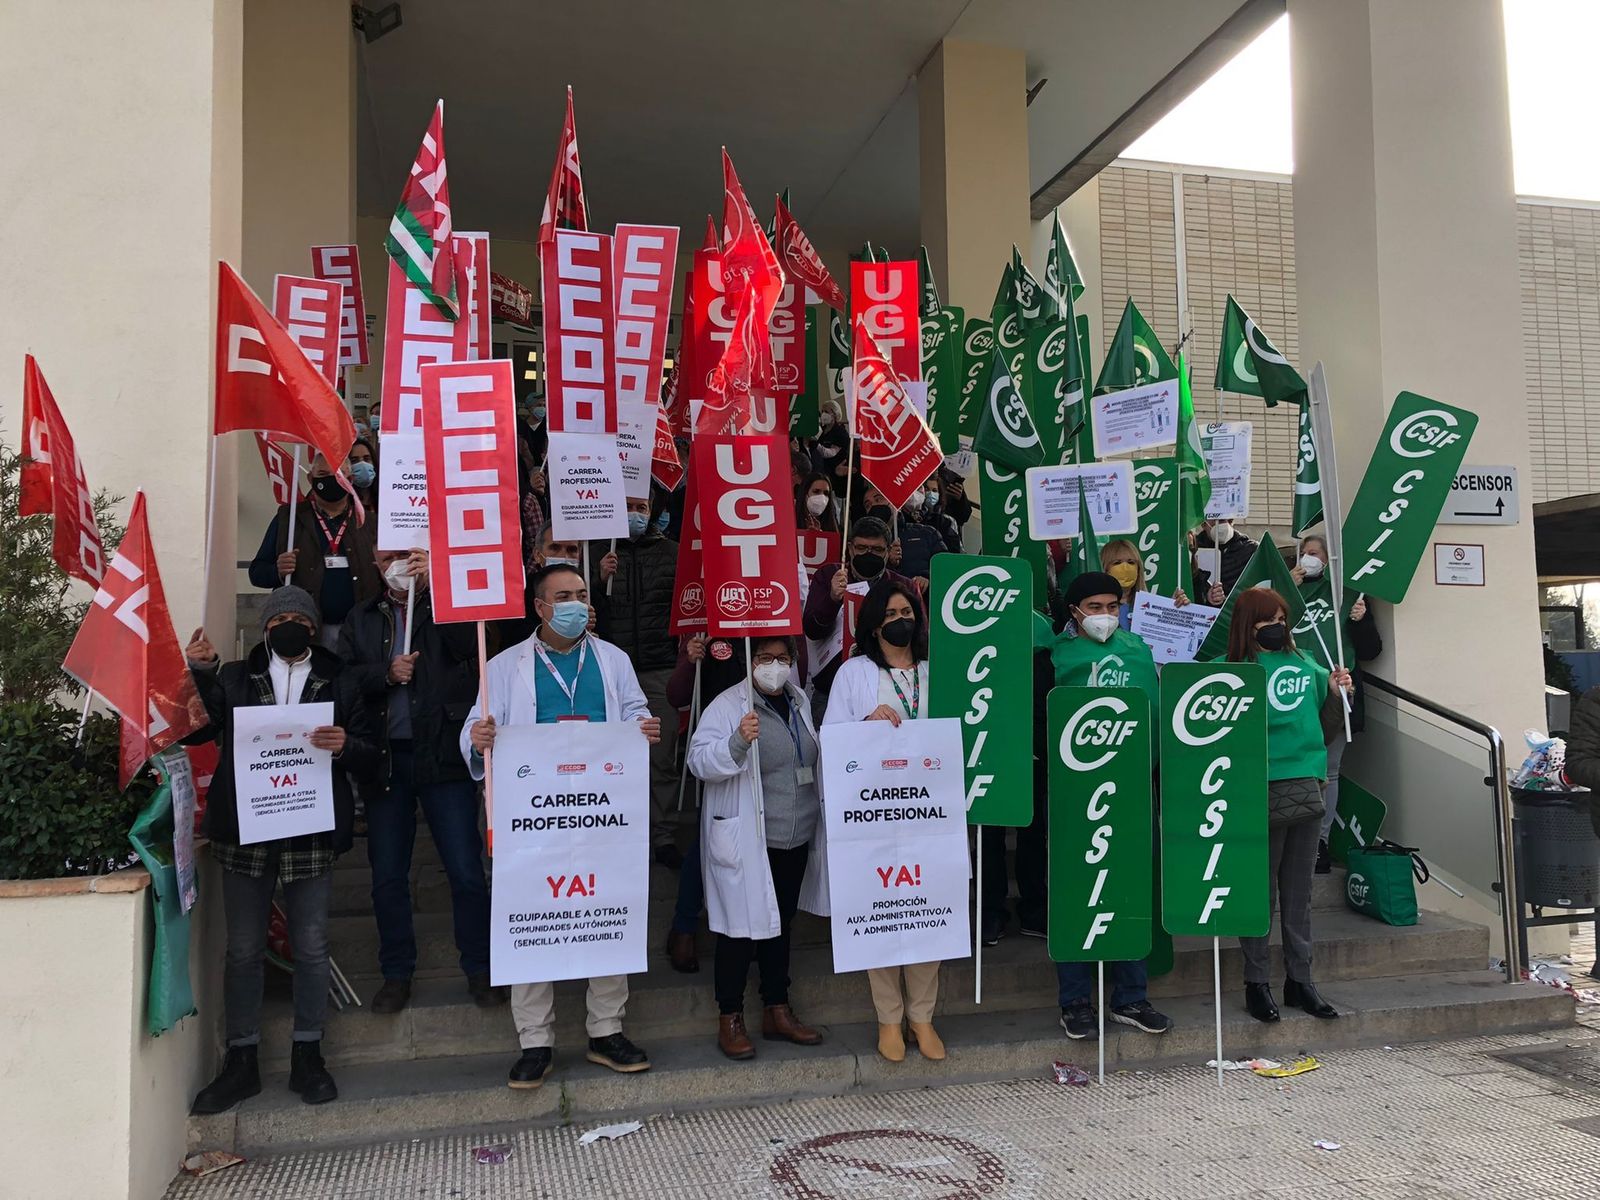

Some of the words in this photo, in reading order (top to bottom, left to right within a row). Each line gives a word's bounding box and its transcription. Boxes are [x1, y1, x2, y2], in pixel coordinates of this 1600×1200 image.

[557, 233, 605, 433] CCOO
[1406, 421, 1461, 449] CSIF
[560, 477, 611, 485] PROFESIONAL
[1452, 475, 1513, 492] SCENSOR
[439, 375, 506, 608] CCOO
[576, 489, 599, 499] YA!
[408, 496, 428, 507] YA
[715, 444, 777, 577] UGT
[1351, 469, 1424, 581] CSIF
[721, 588, 746, 602] UGT
[754, 588, 773, 598] FSP
[957, 586, 1021, 612] CSIF
[1098, 669, 1130, 687] CSIF
[1277, 675, 1311, 697] CSIF
[1188, 696, 1255, 721] CSIF
[965, 646, 997, 811] CSIF
[1075, 720, 1138, 746] CSIF
[260, 748, 305, 758] CARRERA
[250, 757, 315, 771] PROFESIONAL
[269, 773, 298, 788] YA!
[251, 792, 292, 803] EQUIPARABLE
[297, 789, 317, 797] OTRAS
[531, 792, 610, 809] CARRERA
[859, 786, 930, 802] CARRERA
[511, 814, 629, 832] PROFESIONAL
[844, 806, 948, 824] PROFESIONAL
[1198, 756, 1232, 924] CSIF
[1082, 781, 1116, 950] CSIF
[877, 864, 921, 888] YA!
[546, 873, 596, 898] YA!
[1350, 883, 1369, 898] CSIF
[872, 895, 927, 910] PROMOCIÓN
[508, 909, 582, 923] EQUIPARABLE
[583, 908, 592, 917] A
[593, 906, 629, 917] OTRAS
[846, 915, 868, 925] AUX.
[869, 907, 953, 923] ADMINISTRATIVO/A
[509, 922, 571, 935] COMUNIDADES
[572, 918, 627, 931] AUTÓNOMAS
[853, 926, 860, 936] A
[864, 919, 947, 935] ADMINISTRATIVO/A
[513, 936, 561, 949] (SENCILLA
[562, 935, 569, 944] Y
[570, 931, 624, 943] ASEQUIBLE)
